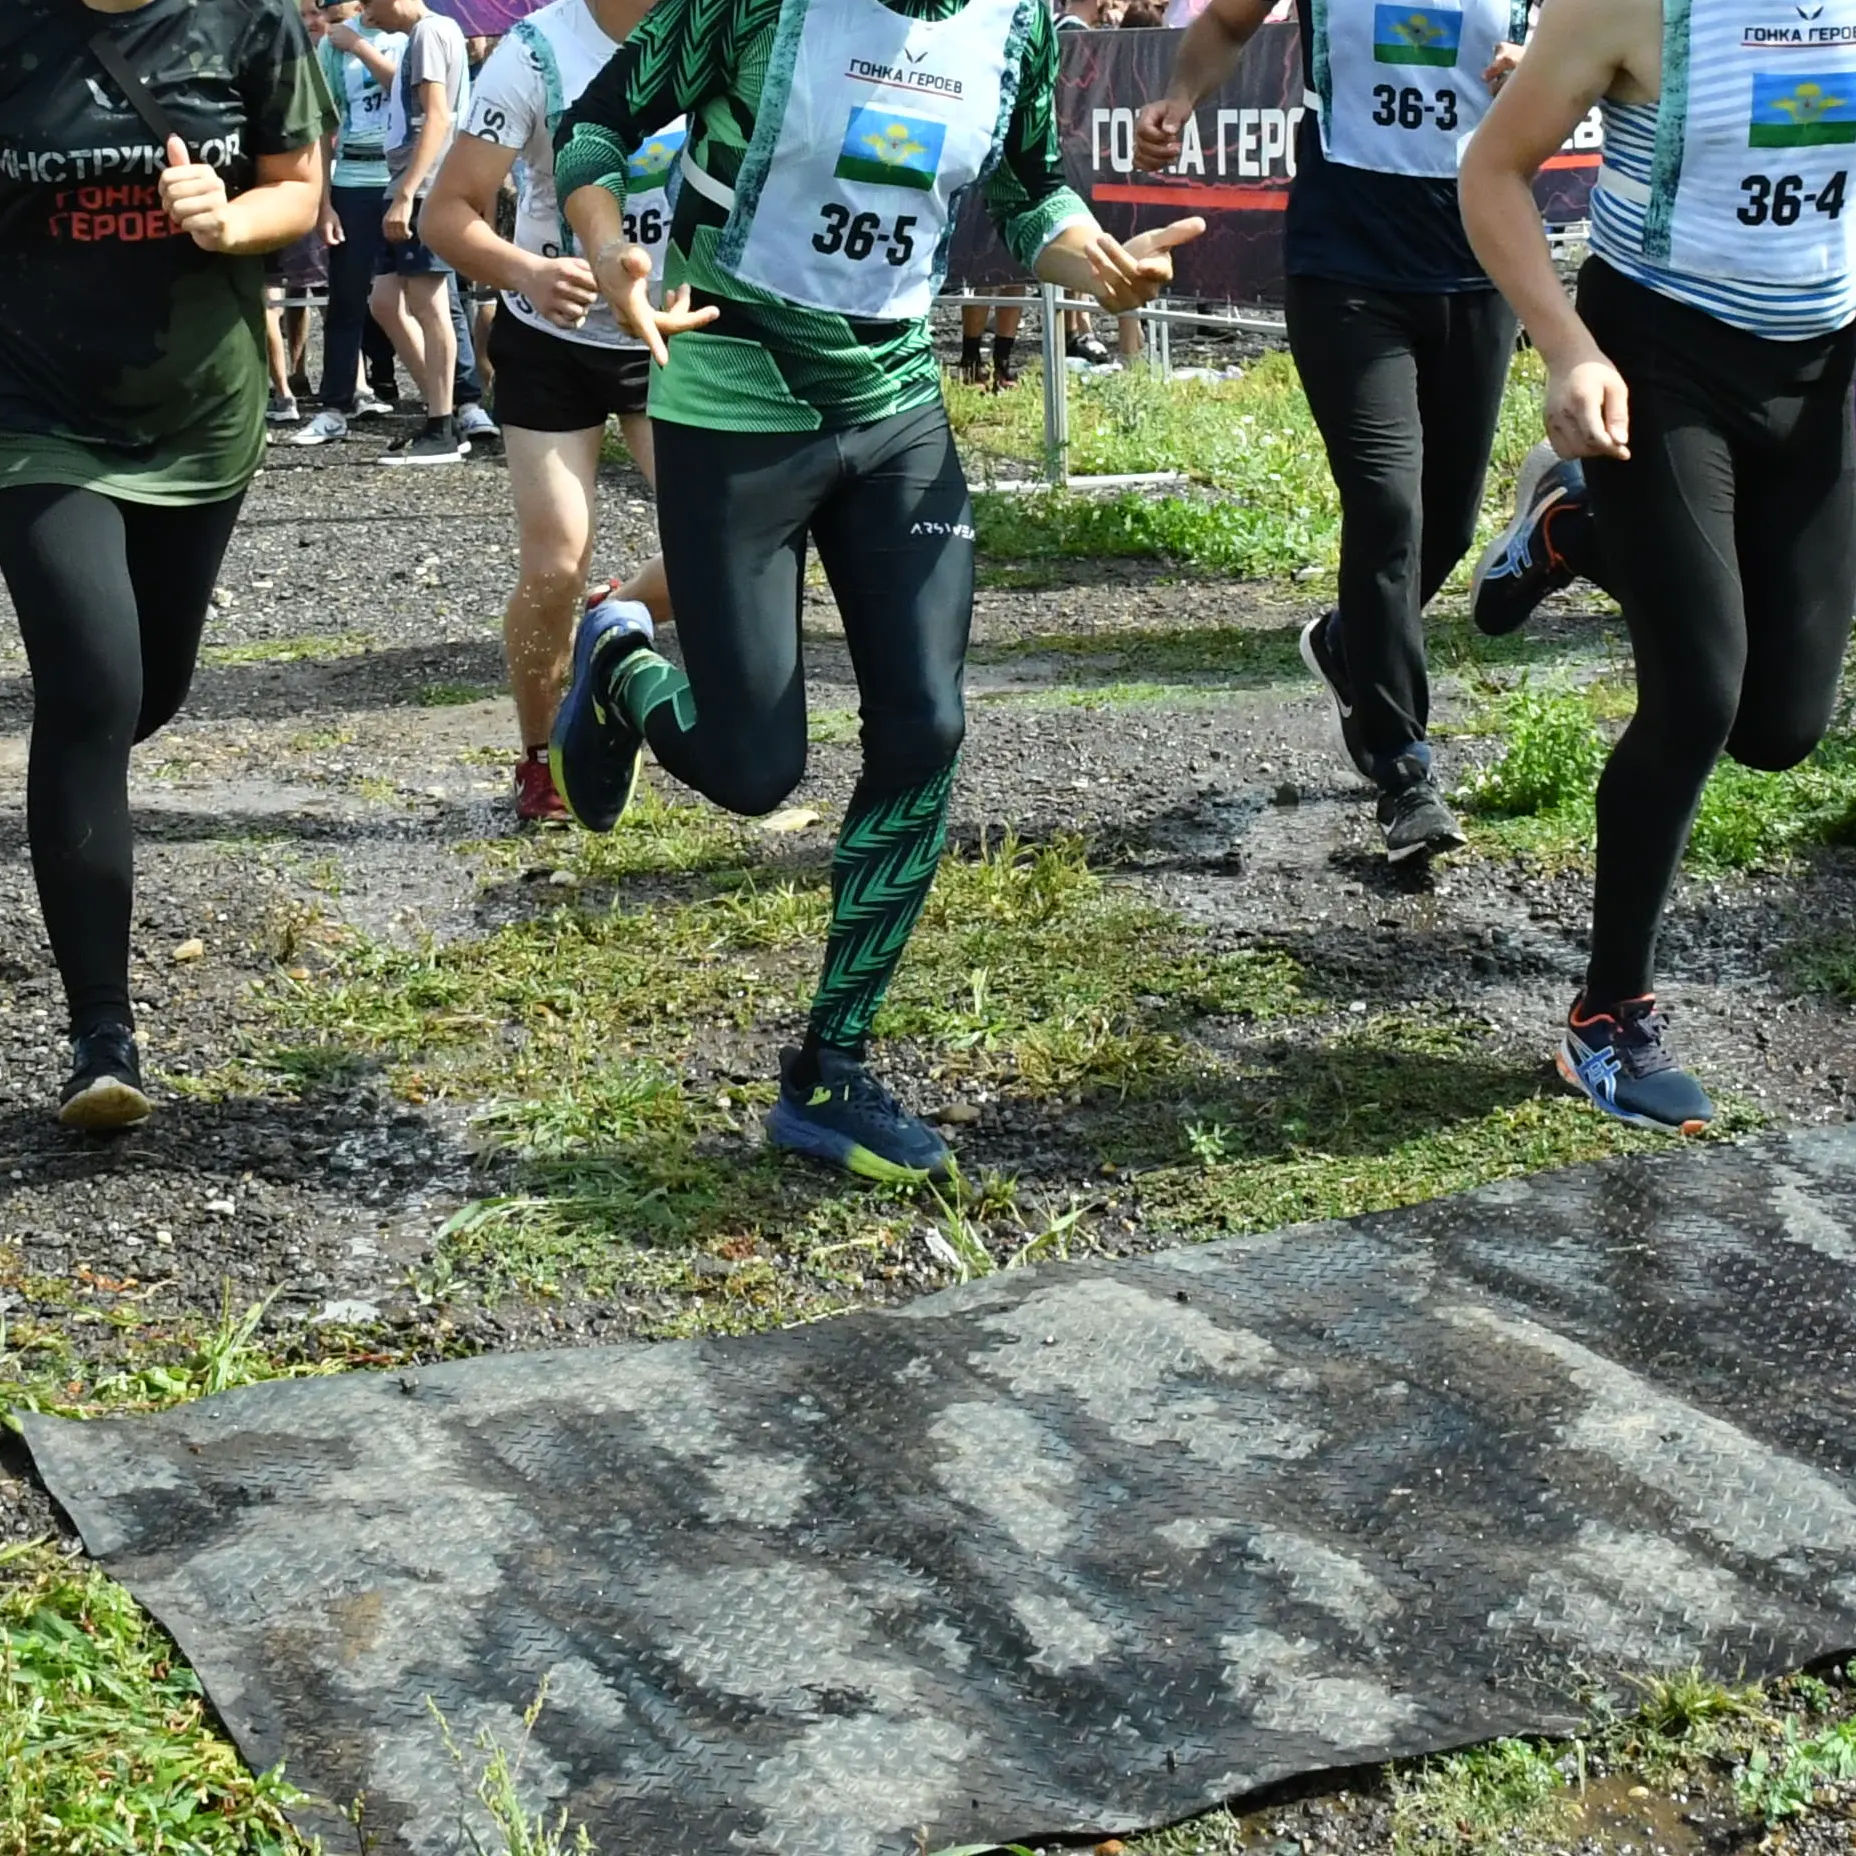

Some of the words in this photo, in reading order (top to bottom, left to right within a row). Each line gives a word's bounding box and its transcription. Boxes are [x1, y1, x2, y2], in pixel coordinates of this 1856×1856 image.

[1744, 26, 1802, 42] ГОНКА
[849, 58, 904, 83] ГОНКА
[907, 71, 963, 95] ГЕРОЕВ
[1372, 83, 1458, 132] 36-3
[56, 184, 157, 210] ГОНК
[1736, 170, 1848, 227] 36-4
[811, 202, 918, 267] 36-5
